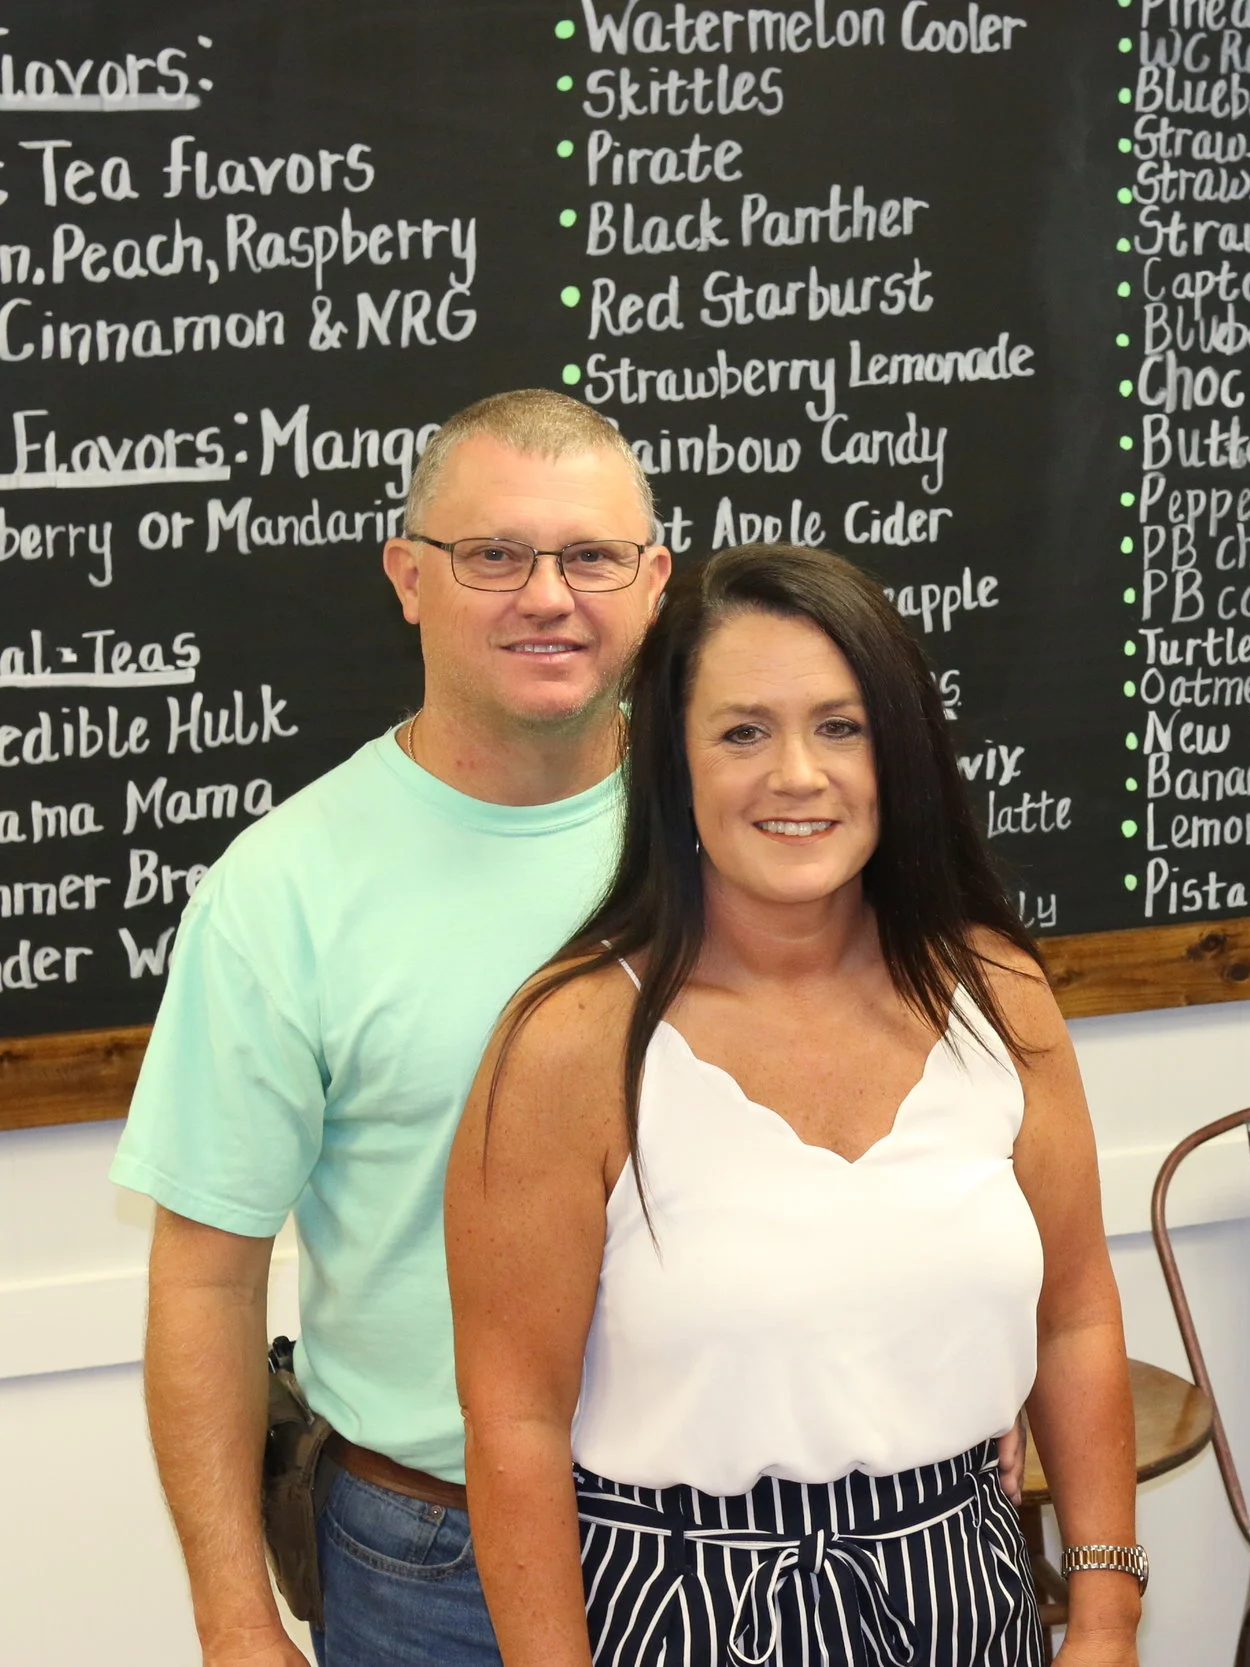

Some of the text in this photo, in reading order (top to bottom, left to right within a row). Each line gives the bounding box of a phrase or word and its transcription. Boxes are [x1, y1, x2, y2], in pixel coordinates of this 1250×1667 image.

[582, 0, 1026, 54] Watermelon Cooler
[0, 28, 212, 99] lavors:
[583, 65, 784, 120] Skittles
[19, 139, 139, 206] Tea
[163, 135, 375, 199] flavors
[587, 130, 743, 186] Pirate
[226, 207, 477, 290] Raspberry
[586, 184, 929, 256] Black Panther
[0, 289, 477, 365] Cinnamon & NRG
[588, 258, 934, 339] Red Starburst
[584, 332, 1035, 422] Strawberry Lemonade
[1138, 349, 1246, 414] Choc
[13, 409, 249, 475] Flavors:
[604, 412, 948, 495] ainbow Candy
[138, 512, 194, 552] or
[845, 500, 953, 548] Cider
[1143, 525, 1197, 573] PB
[883, 566, 1000, 634] apple
[1142, 569, 1205, 624] PB
[167, 684, 299, 755] Hulk
[1143, 709, 1230, 755] New
[122, 776, 277, 836] Mama
[0, 939, 94, 990] der
